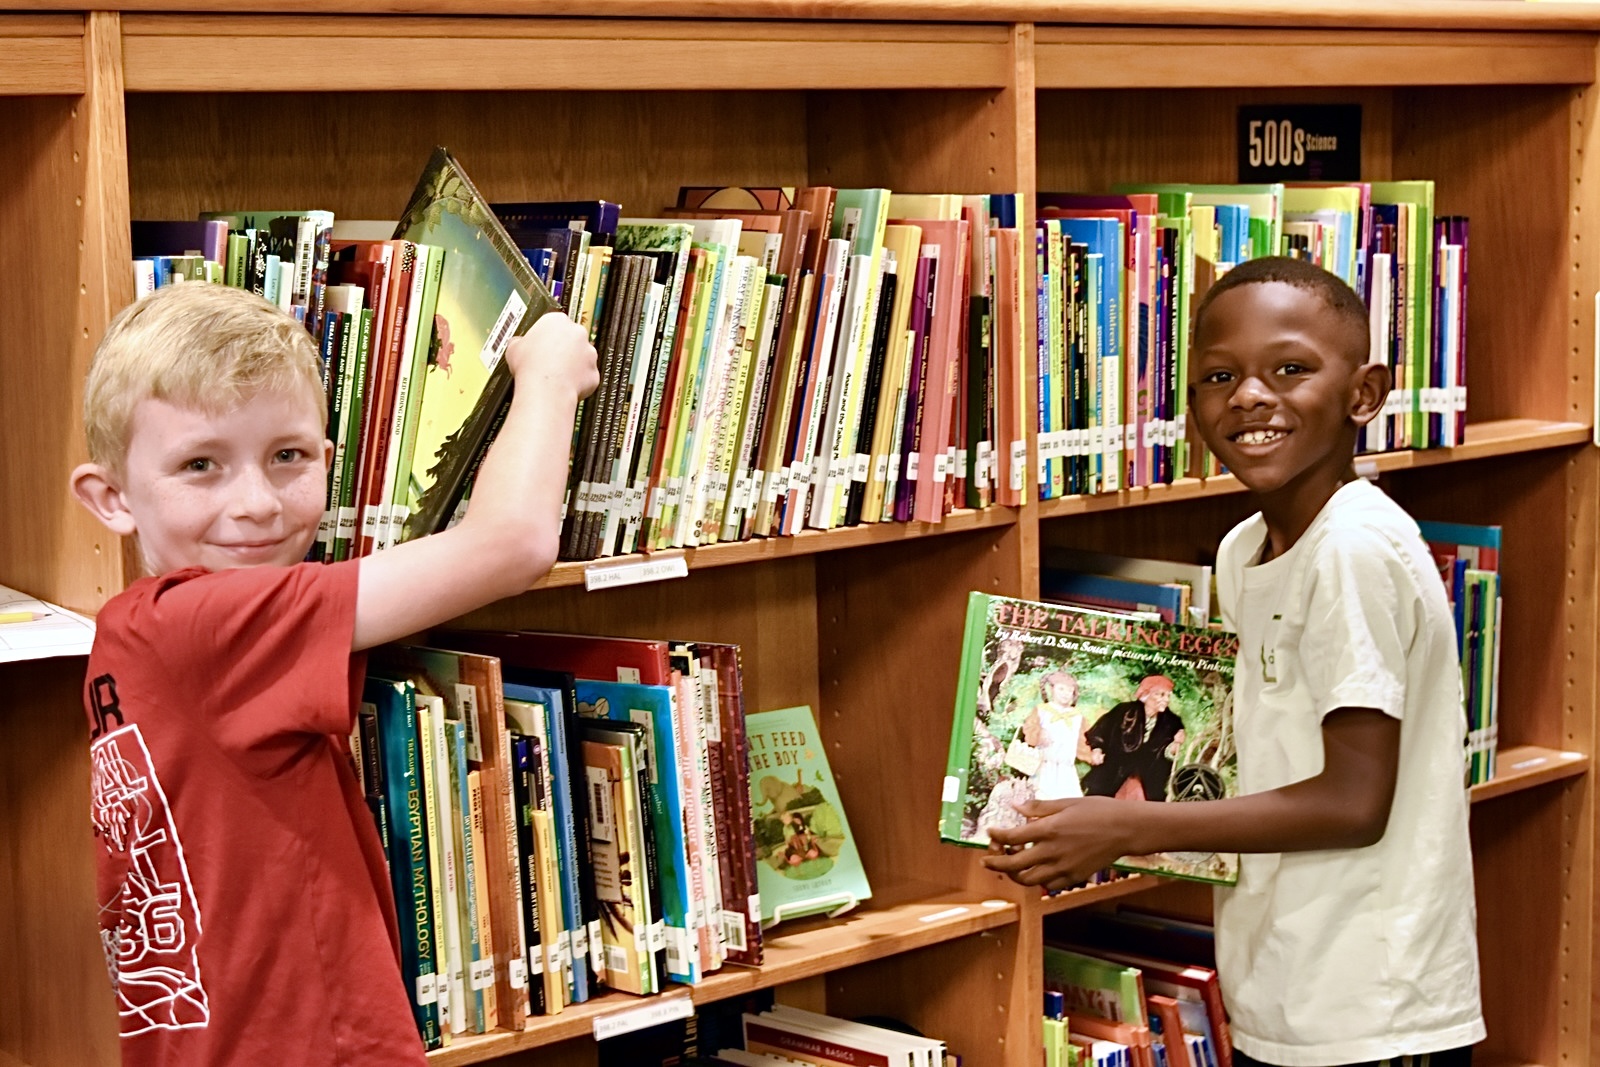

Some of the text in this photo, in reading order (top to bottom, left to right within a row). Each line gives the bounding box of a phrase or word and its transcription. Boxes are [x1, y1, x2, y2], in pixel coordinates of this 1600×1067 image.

[1249, 119, 1337, 167] 500s Science
[1050, 232, 1059, 266] How?
[728, 297, 743, 342] PINKNEY
[748, 299, 760, 329] PINKNEY
[1108, 298, 1116, 352] children's
[340, 335, 348, 356] MOUSE
[721, 361, 731, 382] THE
[730, 348, 740, 372] THE
[757, 359, 766, 376] Little
[356, 363, 364, 398] BEANSTALK
[645, 324, 675, 444] LITTLE RED RIDING HOOD
[738, 364, 747, 385] THE
[842, 372, 852, 396] Anansi
[334, 386, 342, 412] WIZARD
[590, 346, 614, 445] JAPANESE MYTHOLOGY
[601, 353, 623, 442] INDIAN MYTHOLOGY
[606, 330, 636, 462] MIDDLE EASTERN MYTHOLOGY
[684, 373, 694, 405] CINDERELLA
[724, 378, 735, 406] LION
[751, 395, 760, 408] and
[394, 376, 408, 435] RED RIDING HOOD
[711, 387, 727, 436] TORTOISE
[732, 390, 743, 416] LION
[749, 409, 757, 420] the
[840, 398, 848, 411] and
[717, 426, 727, 448] THE
[726, 432, 735, 453] THE
[745, 422, 755, 440] Giant
[806, 424, 815, 451] COUNTRY
[832, 426, 843, 451] Talking
[996, 603, 1049, 629] THE
[1056, 613, 1171, 650] TALKING
[994, 628, 1196, 670] by Robert D. San Souci pictures by Jerry
[772, 731, 806, 747] FEED
[405, 738, 417, 775] TREASURY
[776, 750, 800, 767] BOY
[405, 789, 433, 958] EGYPTIAN MYTHOLOGY
[527, 854, 540, 932] DRAGONS MYTHOLOGY
[825, 1047, 854, 1061] BASICS
